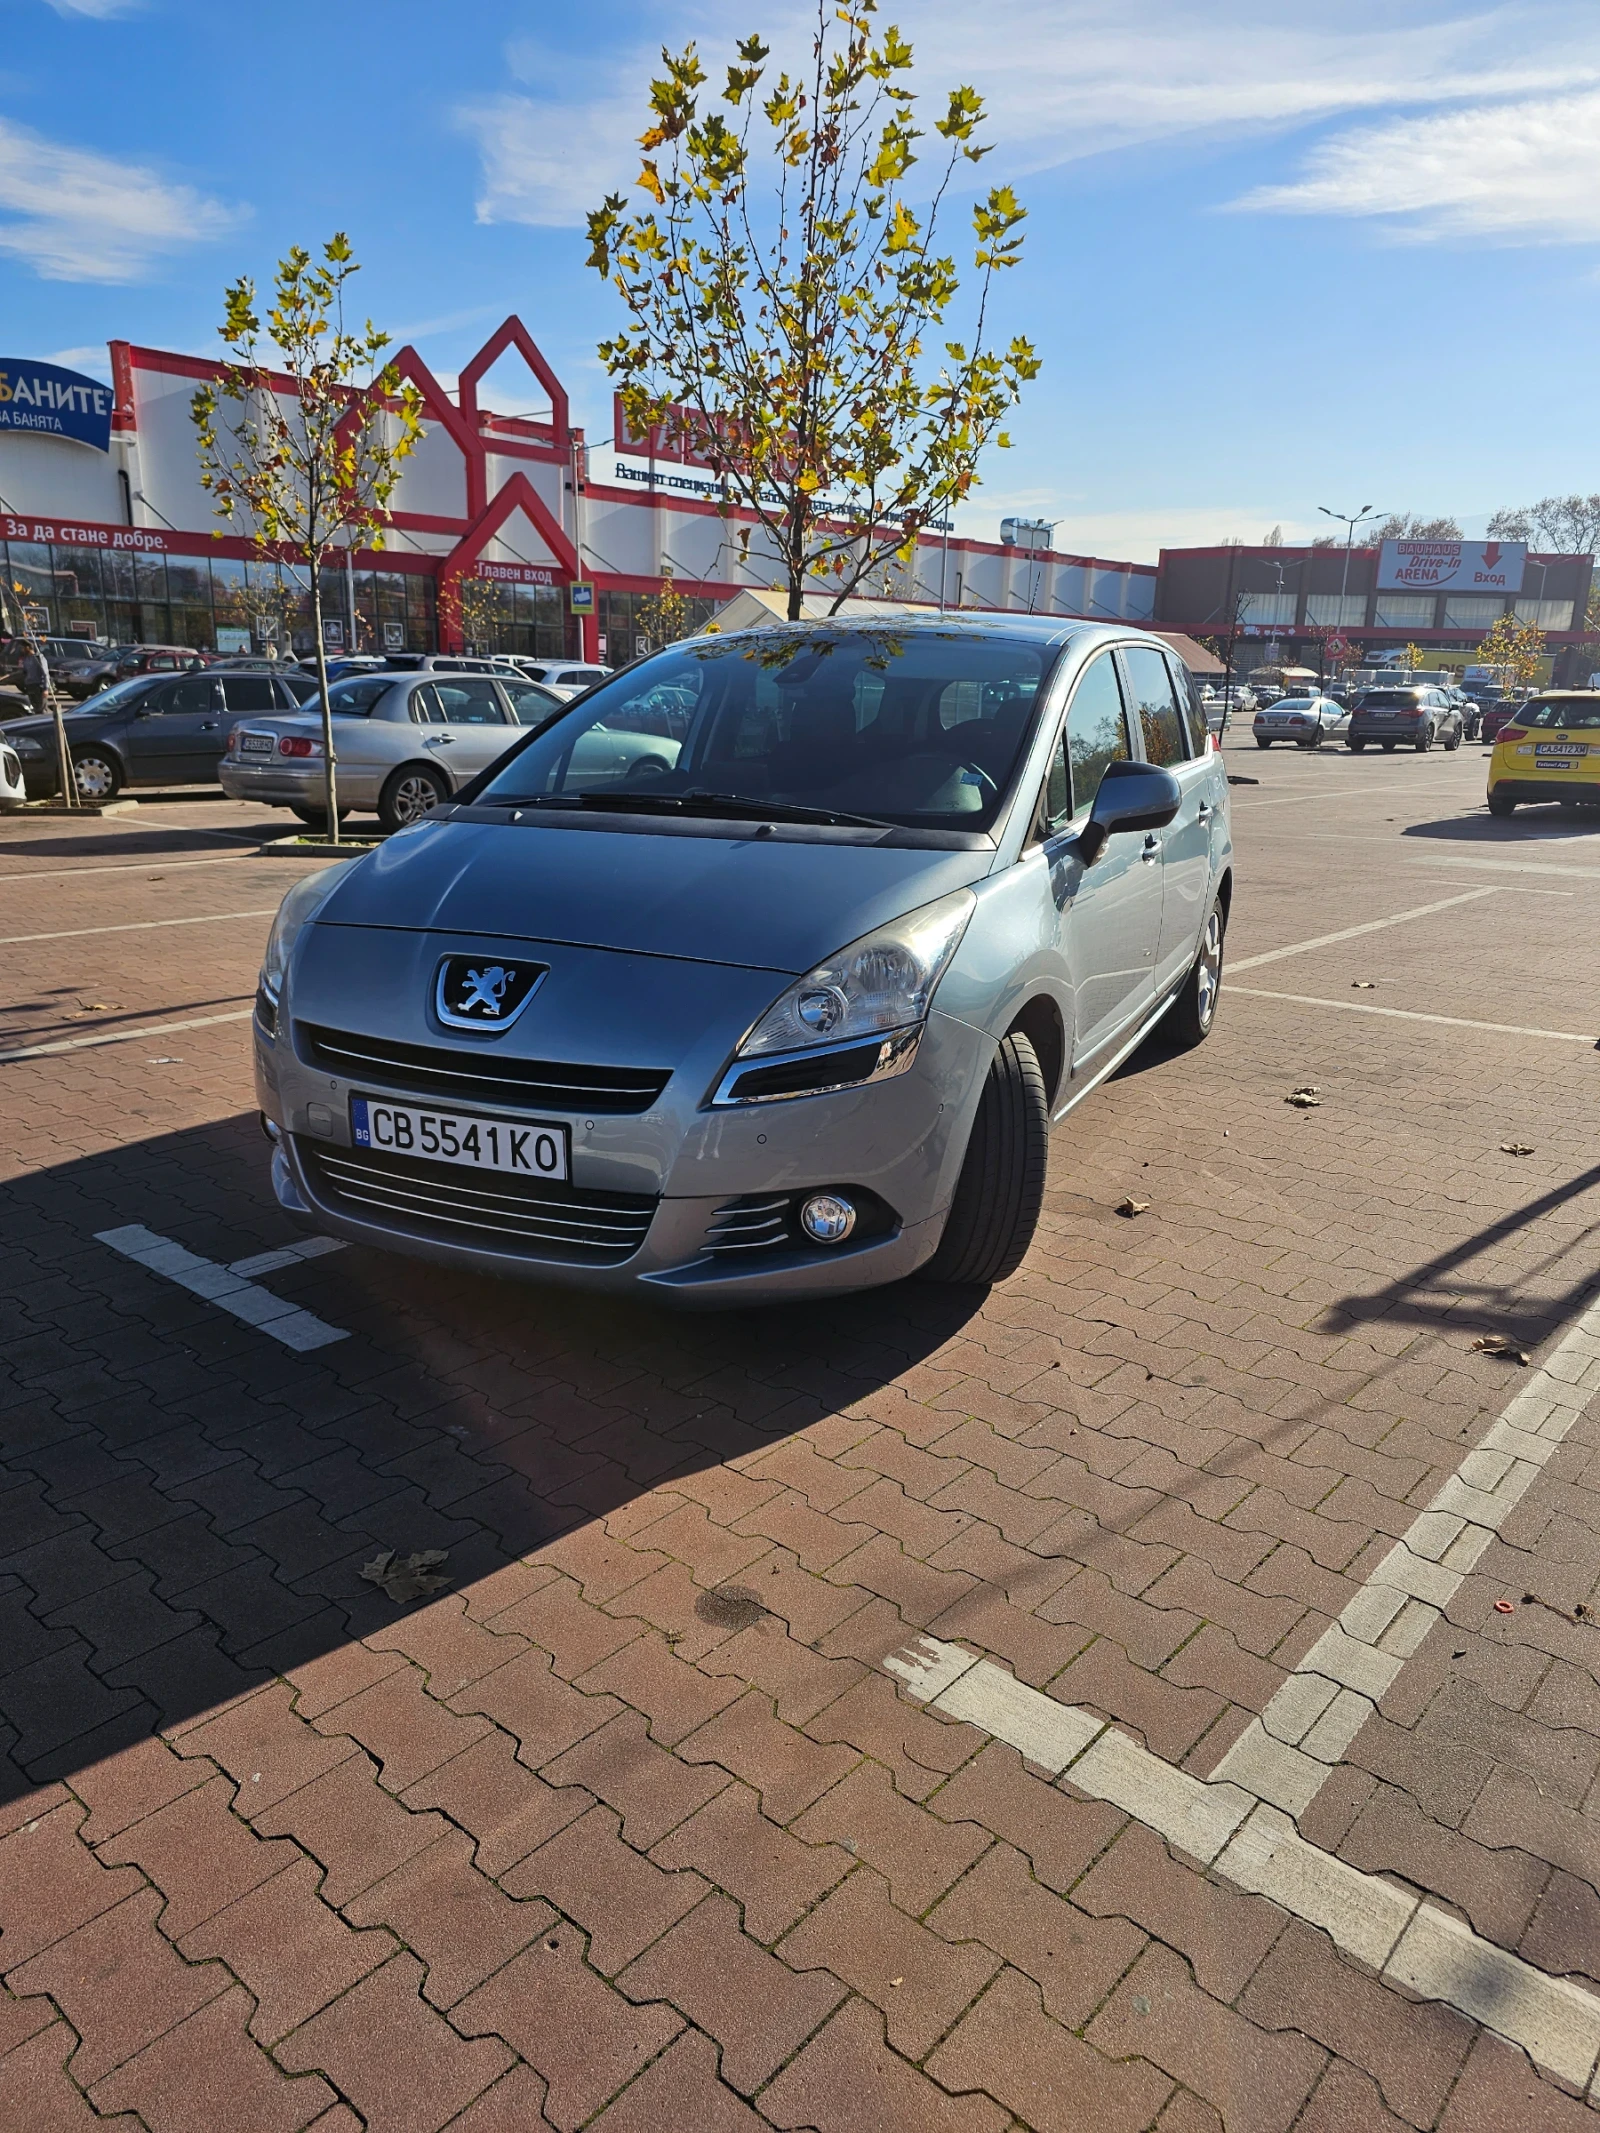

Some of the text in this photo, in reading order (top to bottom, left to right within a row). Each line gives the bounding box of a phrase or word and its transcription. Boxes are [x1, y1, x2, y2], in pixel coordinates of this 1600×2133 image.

[0, 410, 63, 431] А БАНЯТА
[6, 518, 168, 551] За да стане добре.
[1397, 543, 1461, 556] BAUHAUS
[1409, 555, 1462, 568] Drive-In
[478, 562, 553, 585] Главен вход
[1395, 568, 1439, 580] ARENA
[1473, 571, 1506, 586] Вход
[356, 1128, 369, 1141] BG
